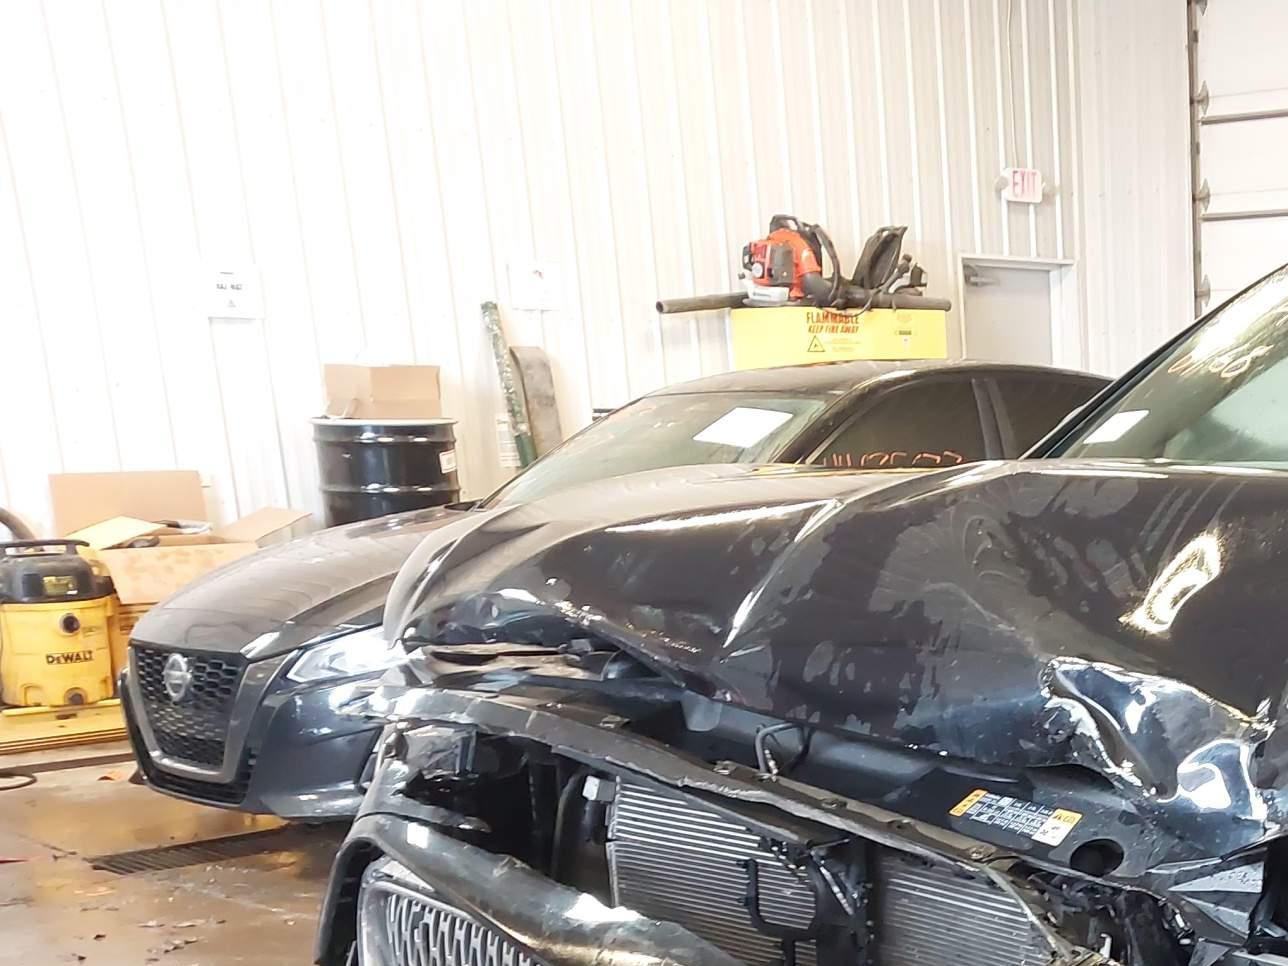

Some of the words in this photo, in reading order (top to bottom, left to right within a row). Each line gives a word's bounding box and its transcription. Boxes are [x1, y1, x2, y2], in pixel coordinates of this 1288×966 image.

[1011, 170, 1038, 197] EXIT
[805, 311, 860, 324] FLAMMABLE
[808, 325, 823, 333] KEEP
[825, 325, 839, 333] FIRE
[840, 325, 859, 333] AWAY
